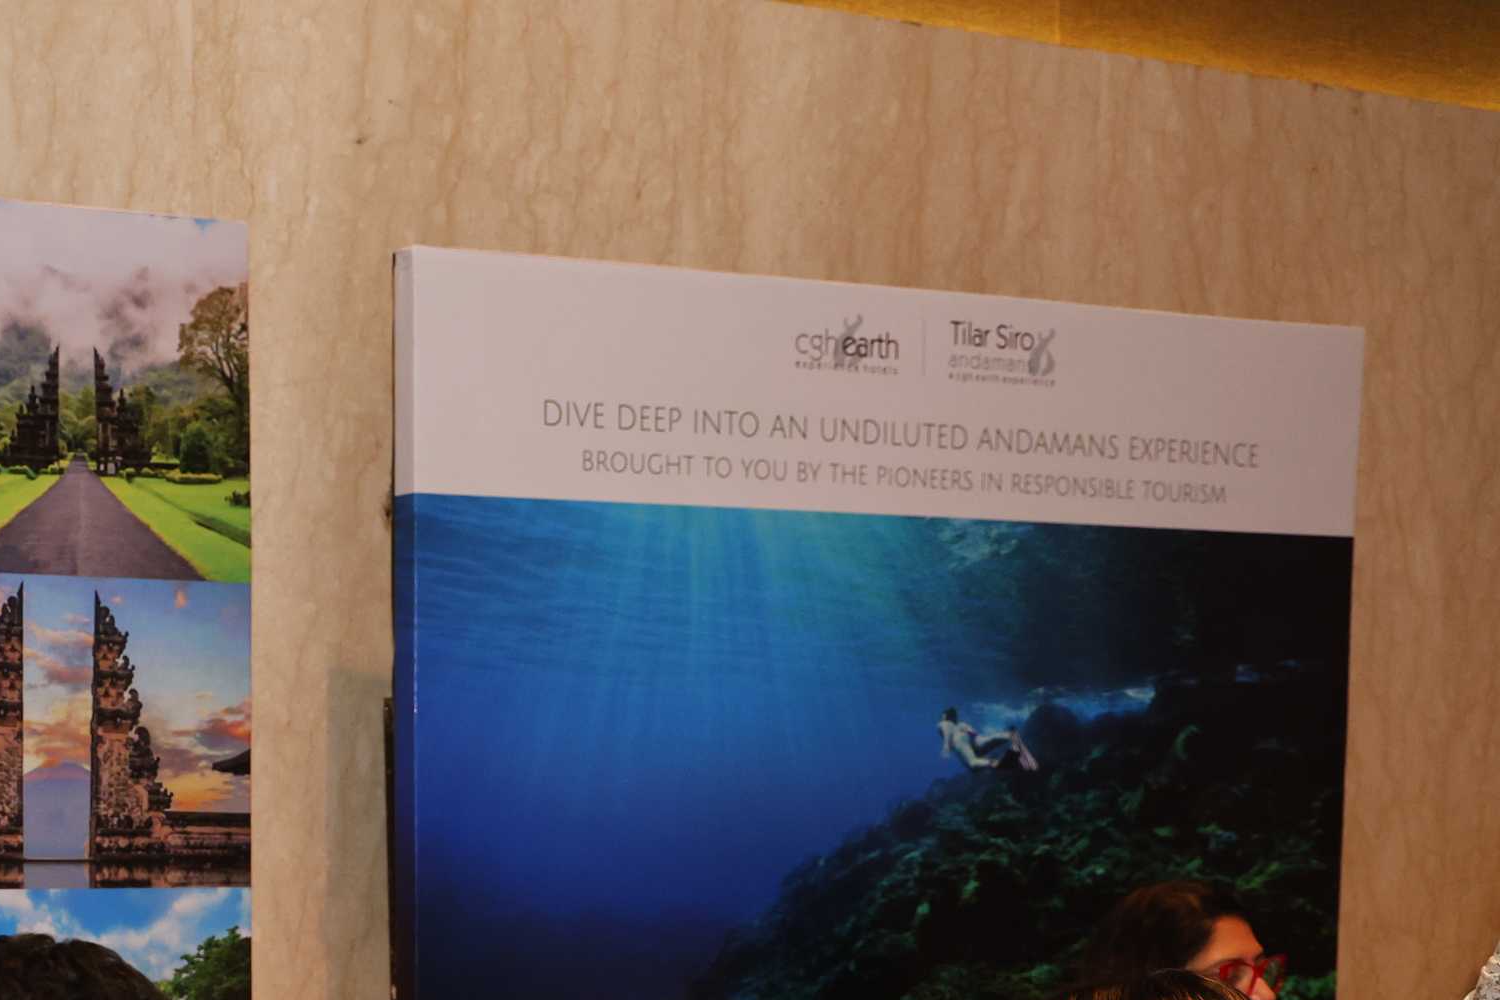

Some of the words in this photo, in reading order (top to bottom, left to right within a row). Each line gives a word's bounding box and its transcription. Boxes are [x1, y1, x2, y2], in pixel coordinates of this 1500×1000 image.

[949, 320, 991, 348] Tilar
[996, 324, 1035, 352] Siro
[543, 399, 605, 430] DIVE
[617, 404, 682, 433] DEEP
[693, 409, 760, 438] INTO
[770, 414, 808, 440] AN
[820, 417, 969, 451] UNDILUTED
[976, 427, 1119, 460] ANDAMANS
[1129, 436, 1260, 469] EXPERIENCE
[582, 449, 694, 476] BROUGHT
[703, 455, 732, 479] TO
[741, 458, 788, 482] YOU
[797, 461, 821, 483] BY
[829, 463, 868, 486] THE
[980, 471, 1003, 493] IN
[1011, 472, 1135, 501] RESPONSIBLE
[1143, 479, 1228, 505] TOURISM
